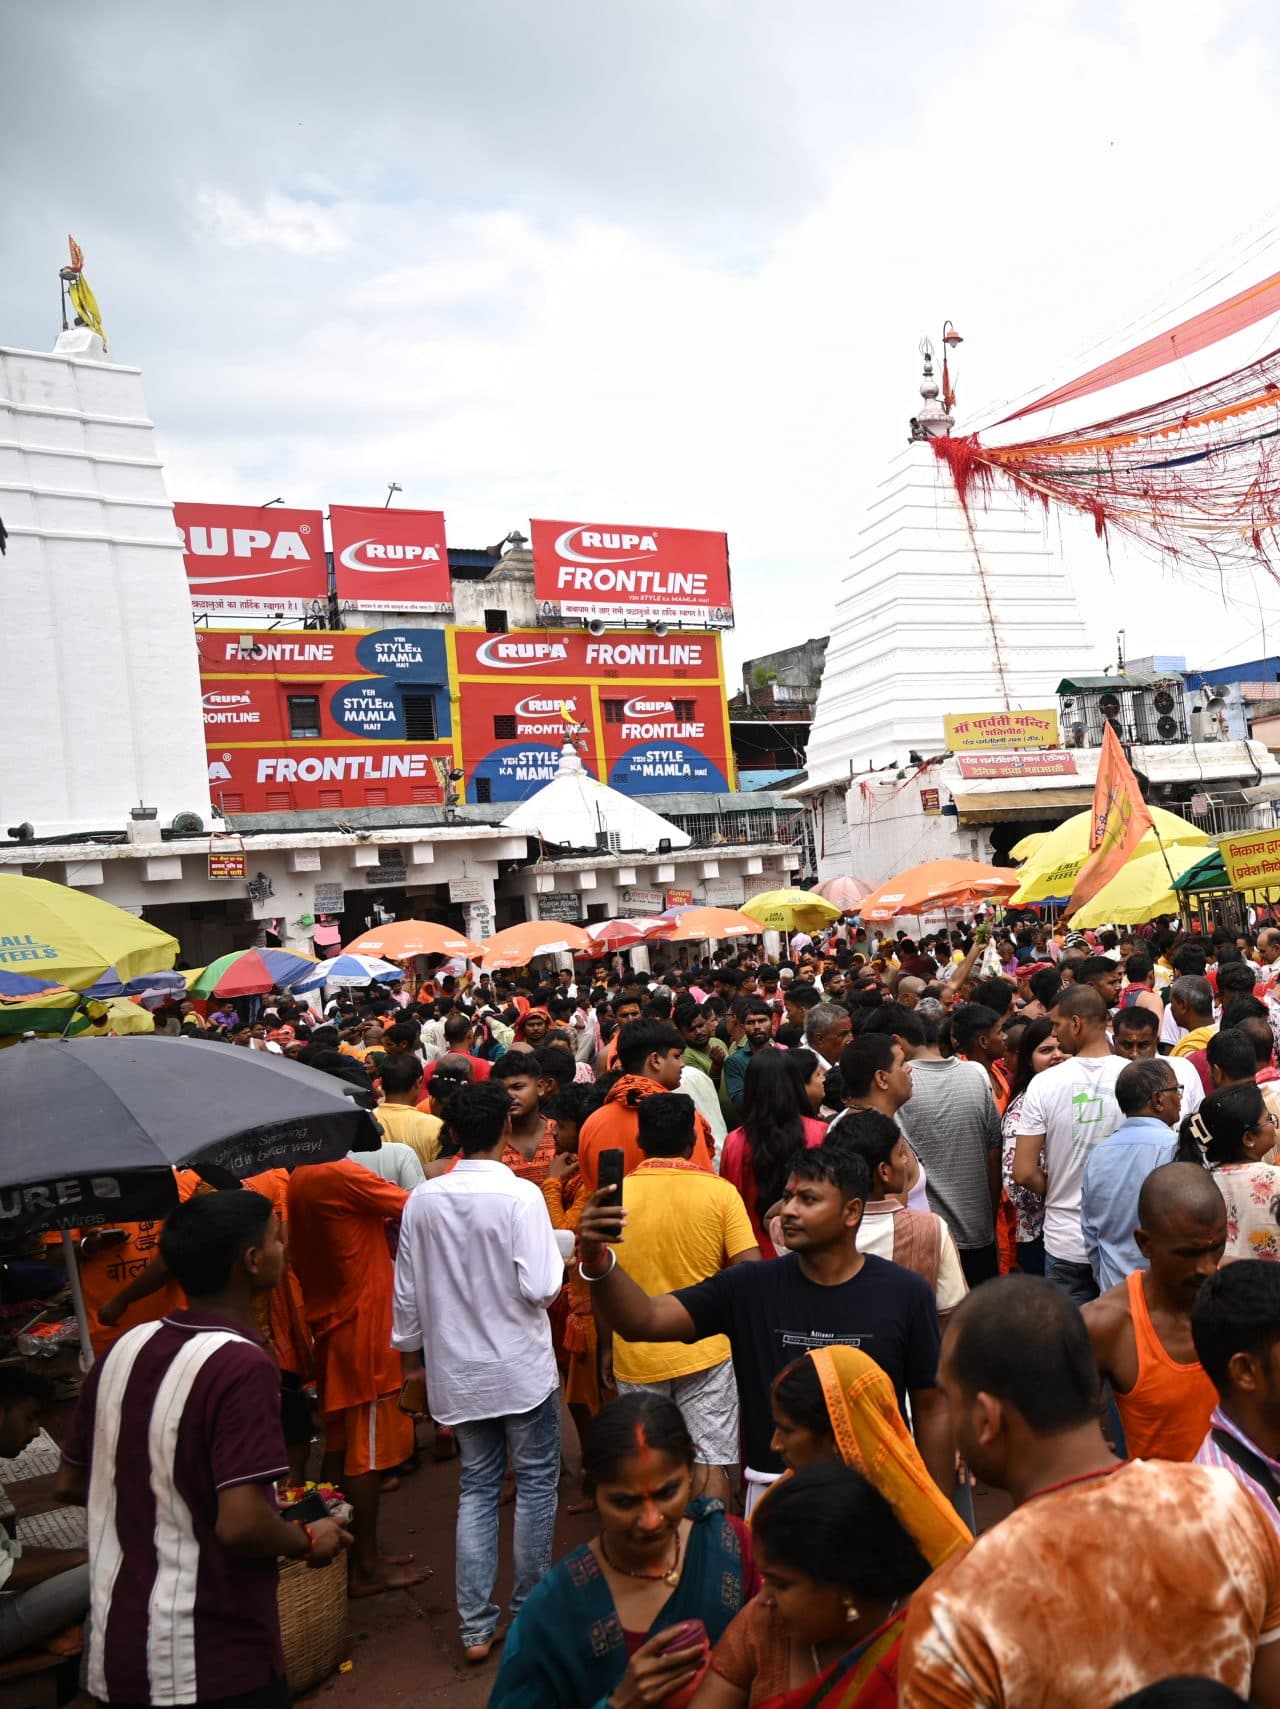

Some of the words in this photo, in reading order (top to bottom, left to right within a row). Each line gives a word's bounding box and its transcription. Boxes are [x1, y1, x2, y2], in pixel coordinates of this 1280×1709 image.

[581, 531, 658, 551] RUPA
[366, 543, 440, 561] RUPA
[557, 566, 708, 595] FRONTLINE
[227, 600, 237, 608] का
[225, 643, 334, 661] FRONTLINE
[375, 643, 412, 654] STYLE
[498, 643, 567, 658] RUPA
[586, 644, 702, 665] FRONTLINE
[377, 652, 423, 663] MAMLA
[210, 694, 251, 703] RUPA
[344, 698, 382, 709] STYLE
[383, 701, 394, 709] KA
[635, 701, 674, 711] RUPA
[203, 712, 261, 723] RONTLINE
[344, 711, 396, 721] MAMLA
[972, 714, 1013, 728] पार्वती
[518, 723, 582, 735] FRONTLIN
[621, 723, 704, 739] FRONTLINE
[502, 757, 518, 765] YEH
[519, 752, 559, 765] STYLE
[646, 751, 683, 763] STYLE
[256, 754, 429, 783] FRONTLINE
[499, 768, 513, 776] KA
[516, 767, 556, 780] MAML
[642, 764, 691, 777] MAMLA
[1229, 843, 1265, 858] निकास
[0, 934, 38, 947] ALL
[0, 947, 58, 963] TEELS
